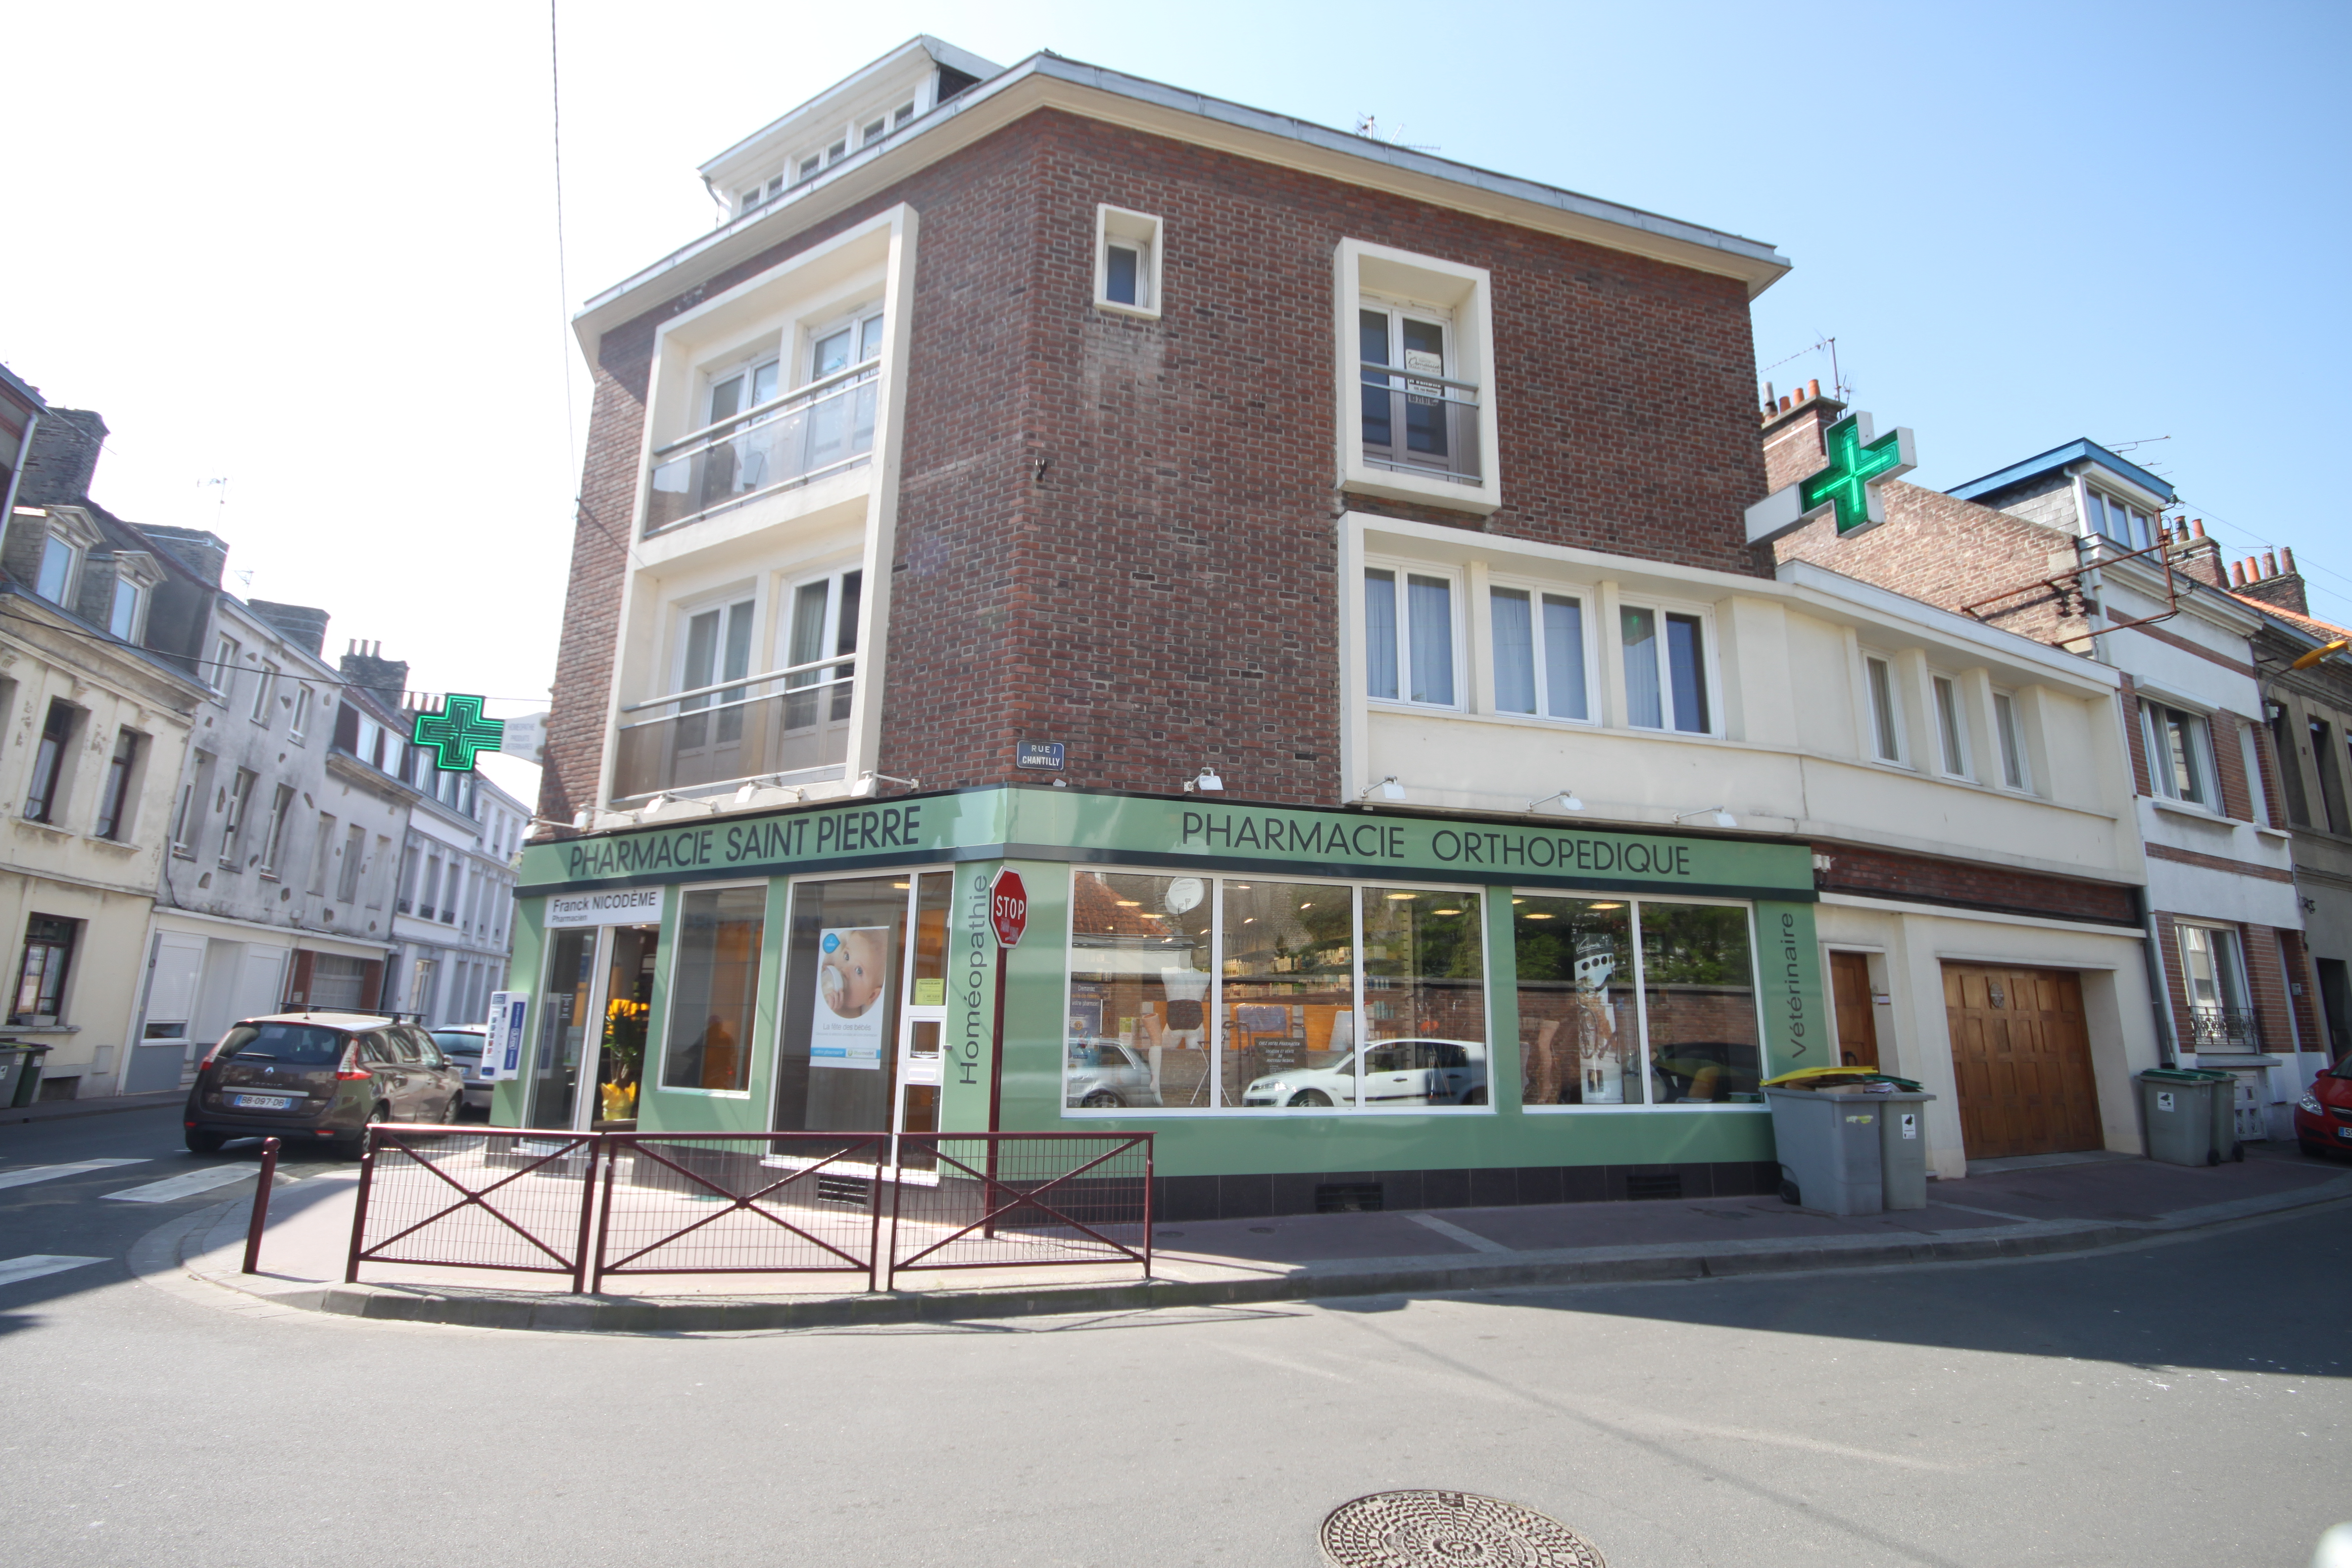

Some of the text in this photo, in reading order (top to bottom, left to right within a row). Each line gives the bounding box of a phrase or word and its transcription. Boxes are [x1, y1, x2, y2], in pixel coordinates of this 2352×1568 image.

[1022, 755, 1060, 766] CHANTILLY
[1031, 744, 1050, 753] RUE
[569, 805, 921, 878] PHARMACIE SAINT PIERRE
[1182, 812, 1690, 876] PHARMACIE ORTHOPEDIQUE
[553, 889, 657, 913] Franck NICODÈME
[996, 895, 1024, 920] STOP
[551, 914, 588, 923] Pharmacien
[959, 875, 987, 1084] Homéopathie
[1781, 913, 1807, 1059] Vétérinaire
[509, 1029, 519, 1049] durex
[241, 1096, 285, 1107] BB-097-DB
